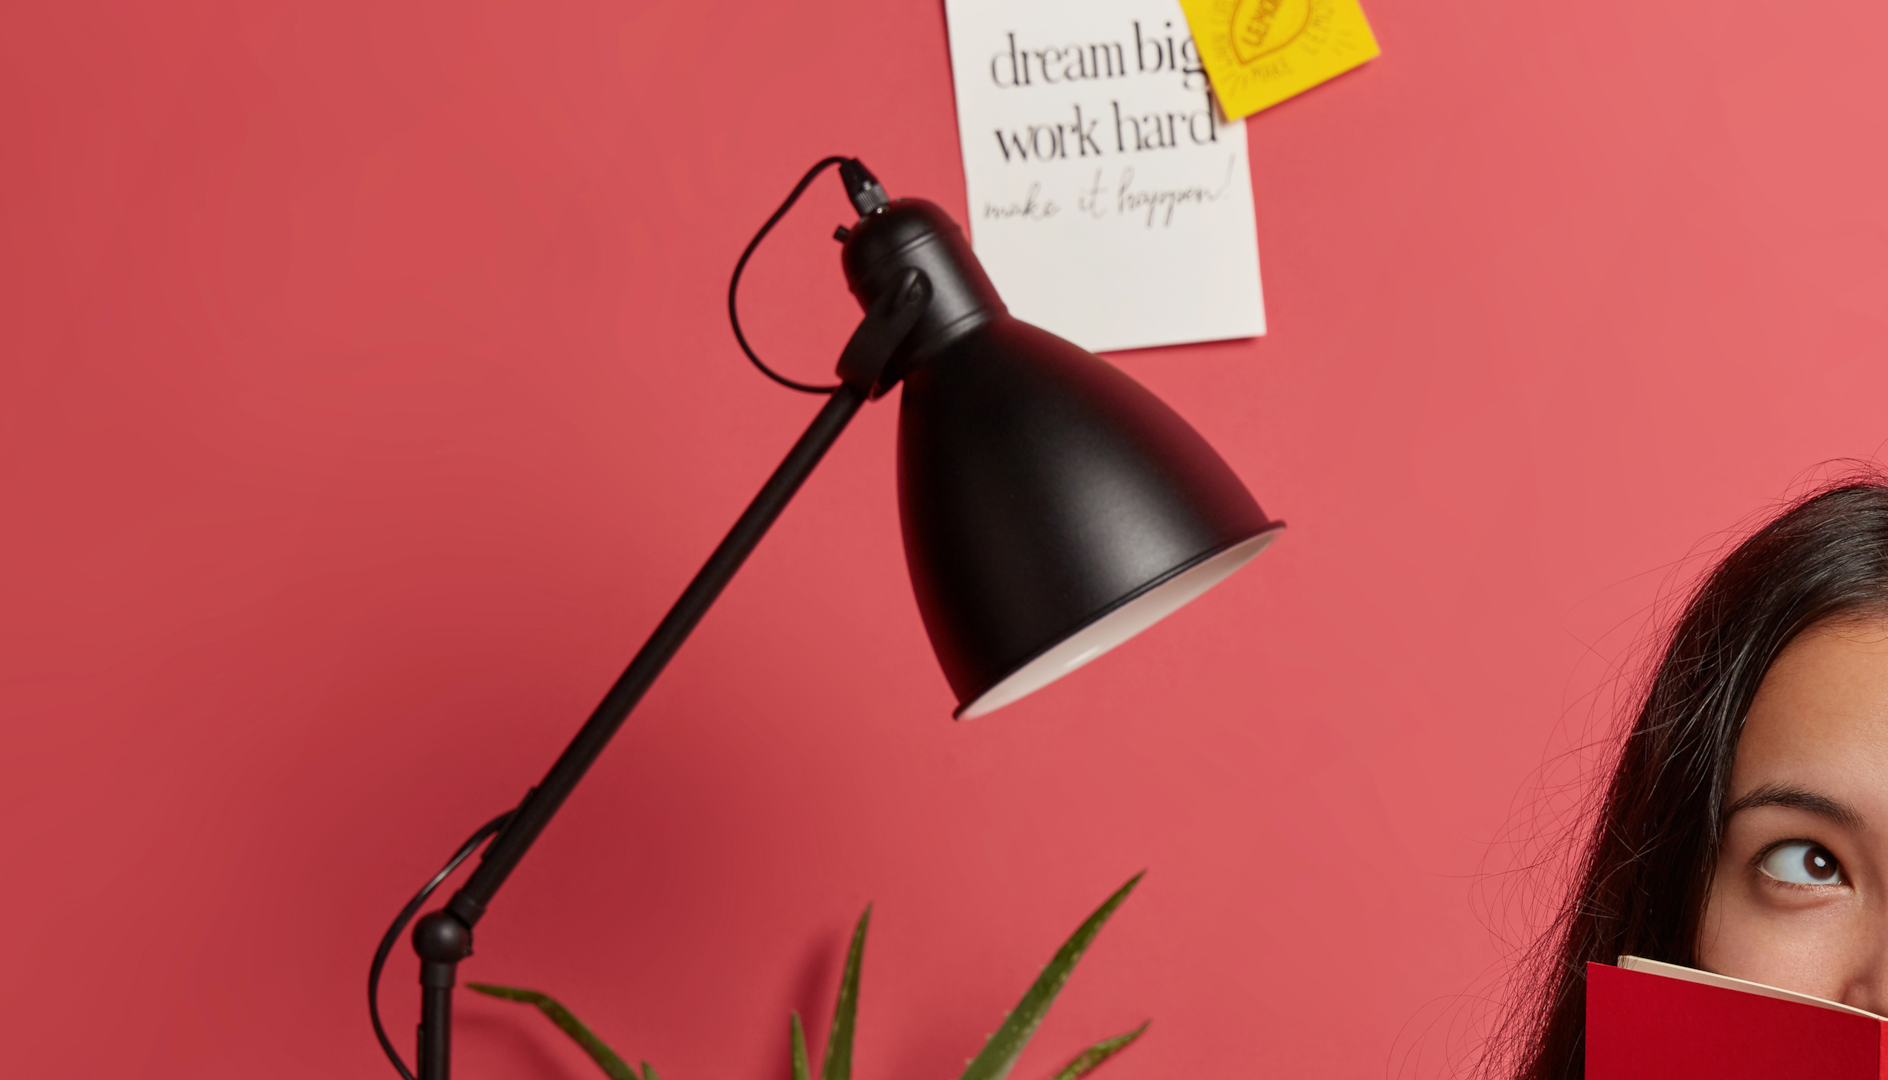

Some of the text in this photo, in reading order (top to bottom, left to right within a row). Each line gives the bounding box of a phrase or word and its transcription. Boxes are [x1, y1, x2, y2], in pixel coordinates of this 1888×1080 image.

[990, 20, 1212, 92] dream big
[994, 91, 1219, 163] work hard
[983, 180, 1061, 221] make
[1078, 166, 1109, 220] it
